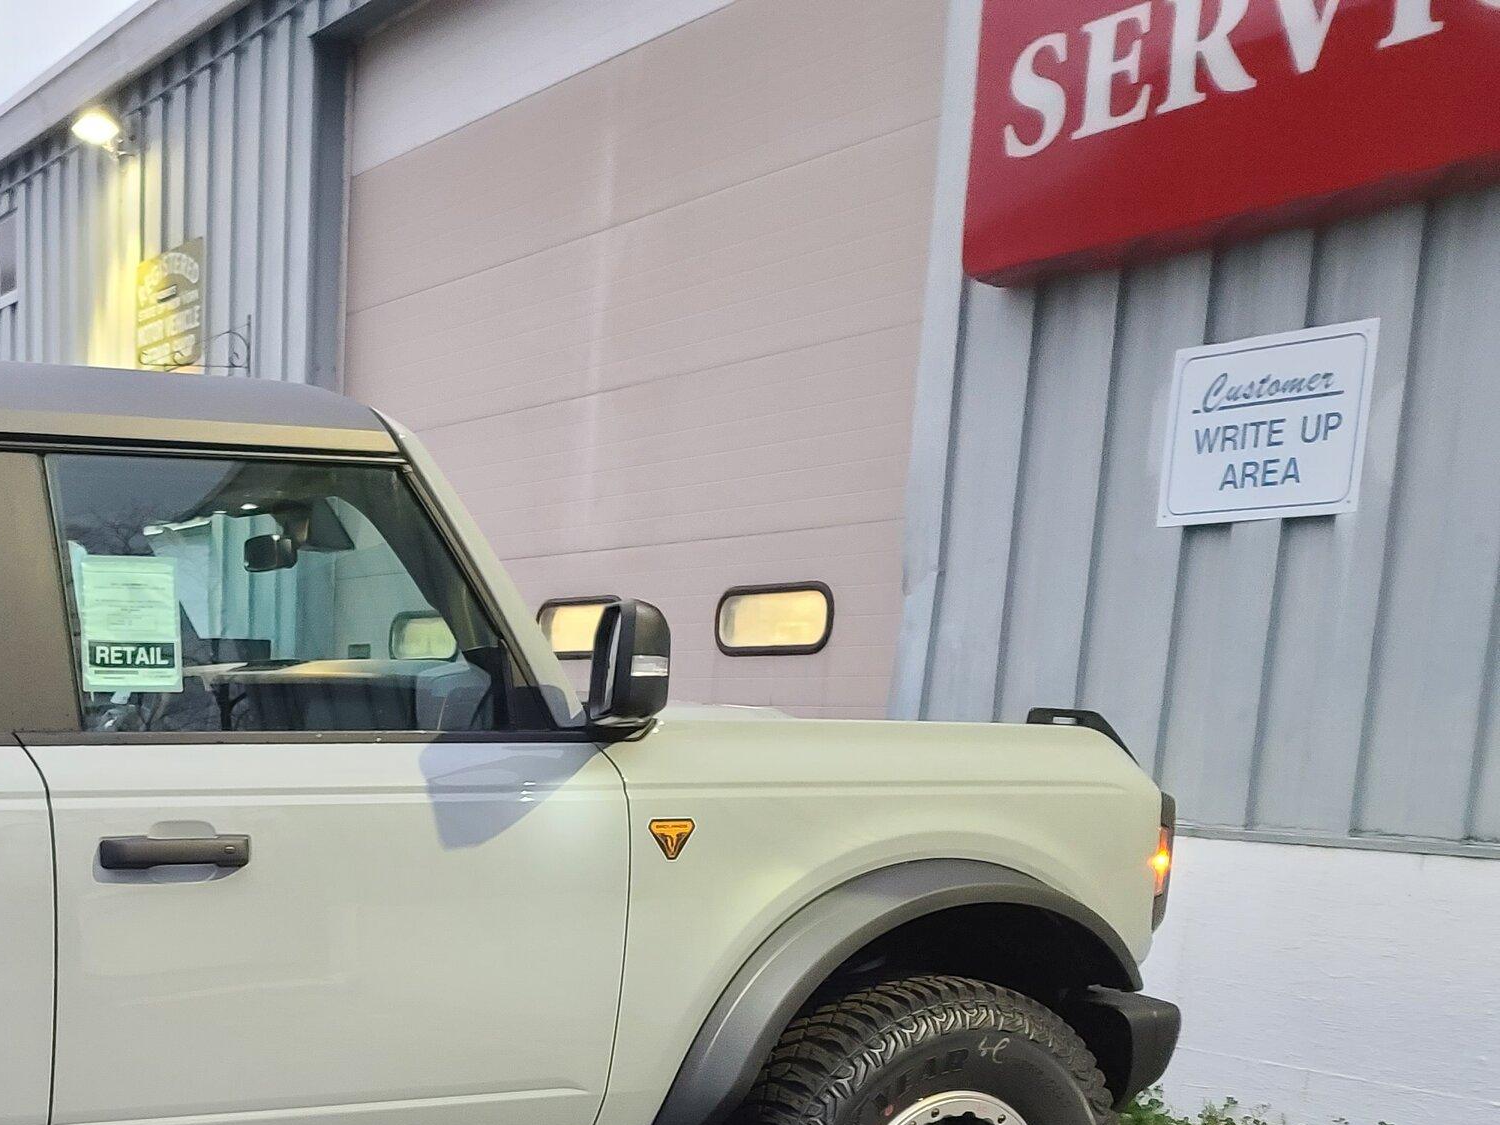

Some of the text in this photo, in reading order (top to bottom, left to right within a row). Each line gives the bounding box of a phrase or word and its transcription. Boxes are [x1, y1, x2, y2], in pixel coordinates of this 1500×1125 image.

[1202, 372, 1334, 413] Customer
[1194, 411, 1343, 455] WRITE UP
[1218, 457, 1301, 491] AREA
[95, 646, 169, 665] RETAIL
